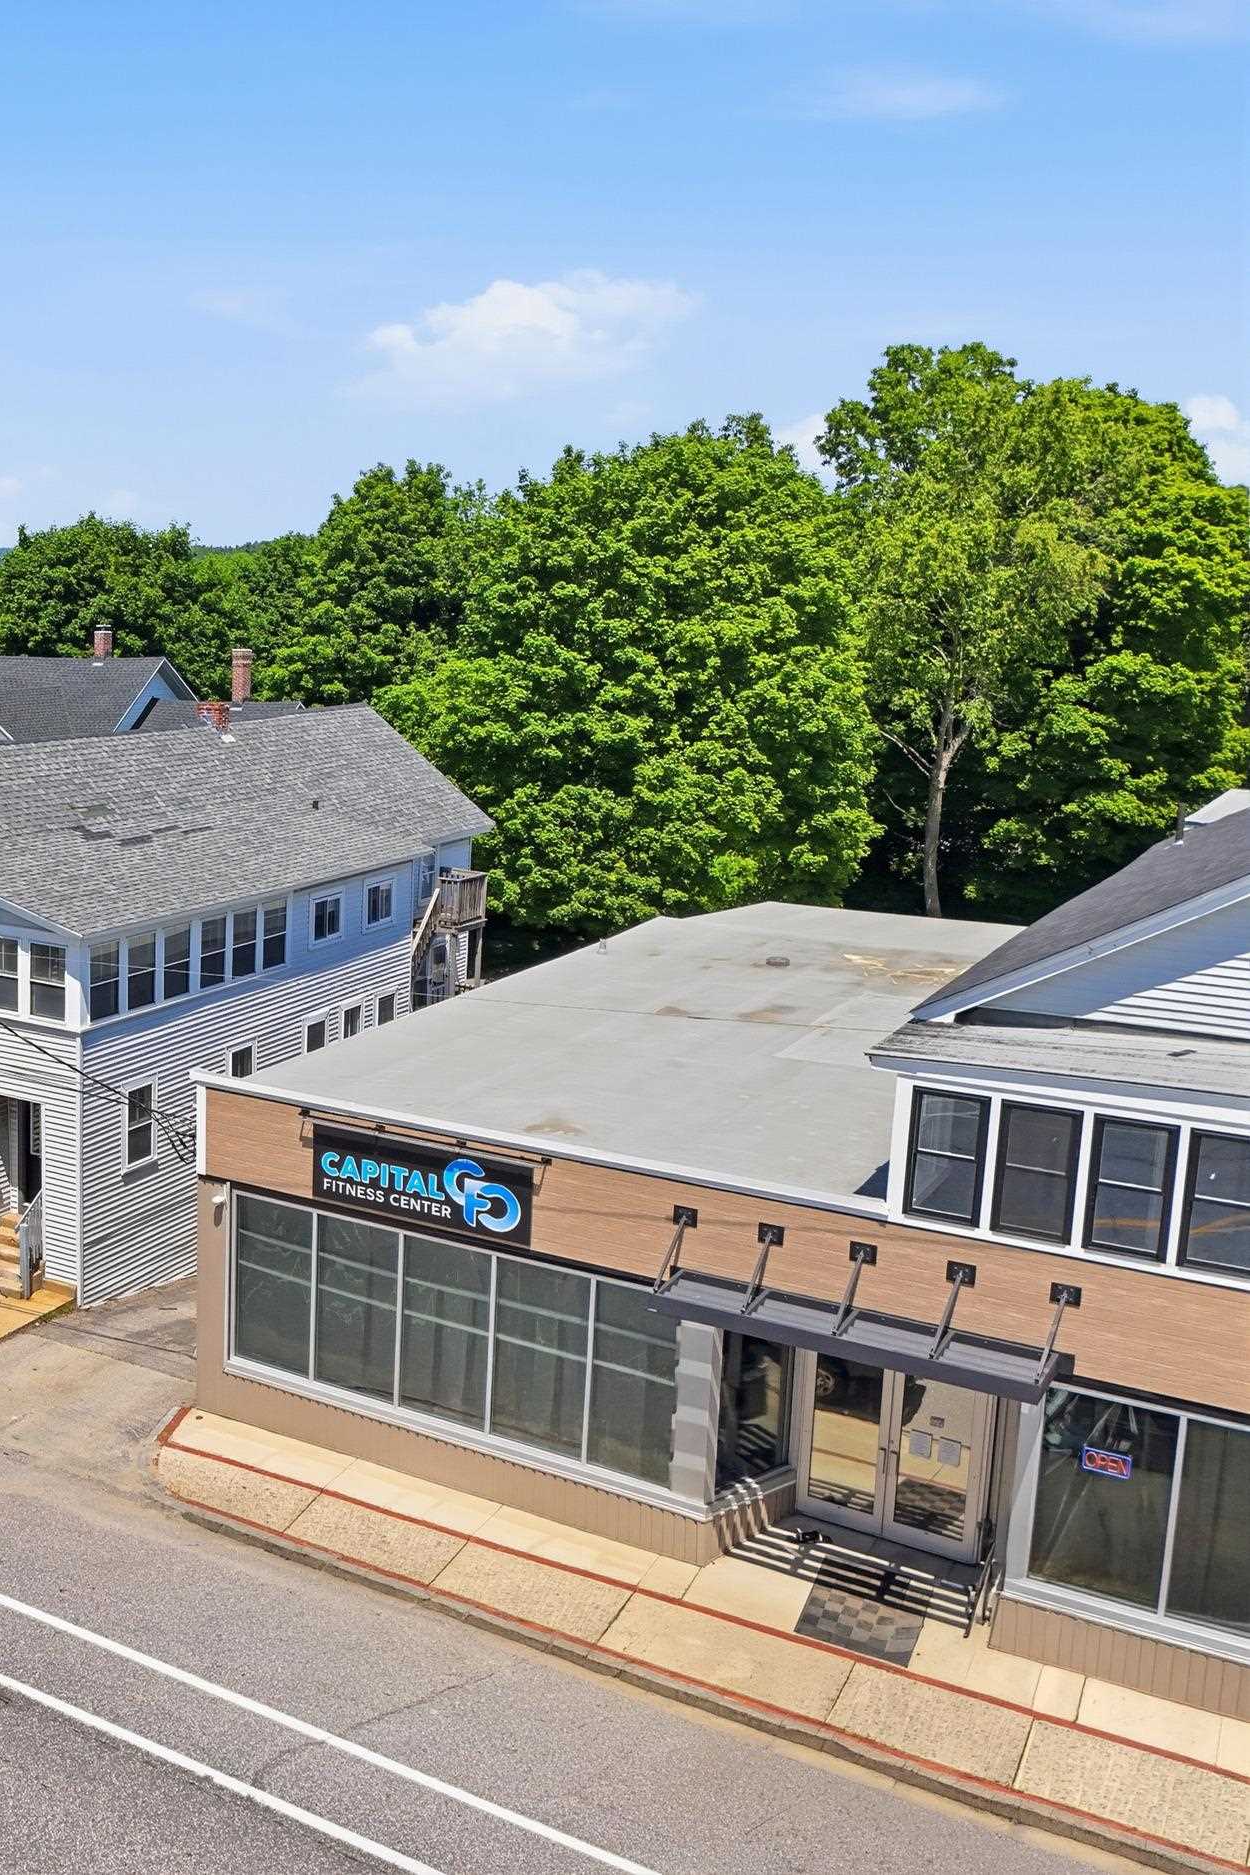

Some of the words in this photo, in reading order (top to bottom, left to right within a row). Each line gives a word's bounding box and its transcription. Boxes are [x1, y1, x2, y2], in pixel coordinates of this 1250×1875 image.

[321, 1151, 446, 1201] CAPITAL
[323, 1178, 385, 1203] FITNESS
[389, 1194, 452, 1219] CENTER
[1085, 1451, 1128, 1476] OPEN
